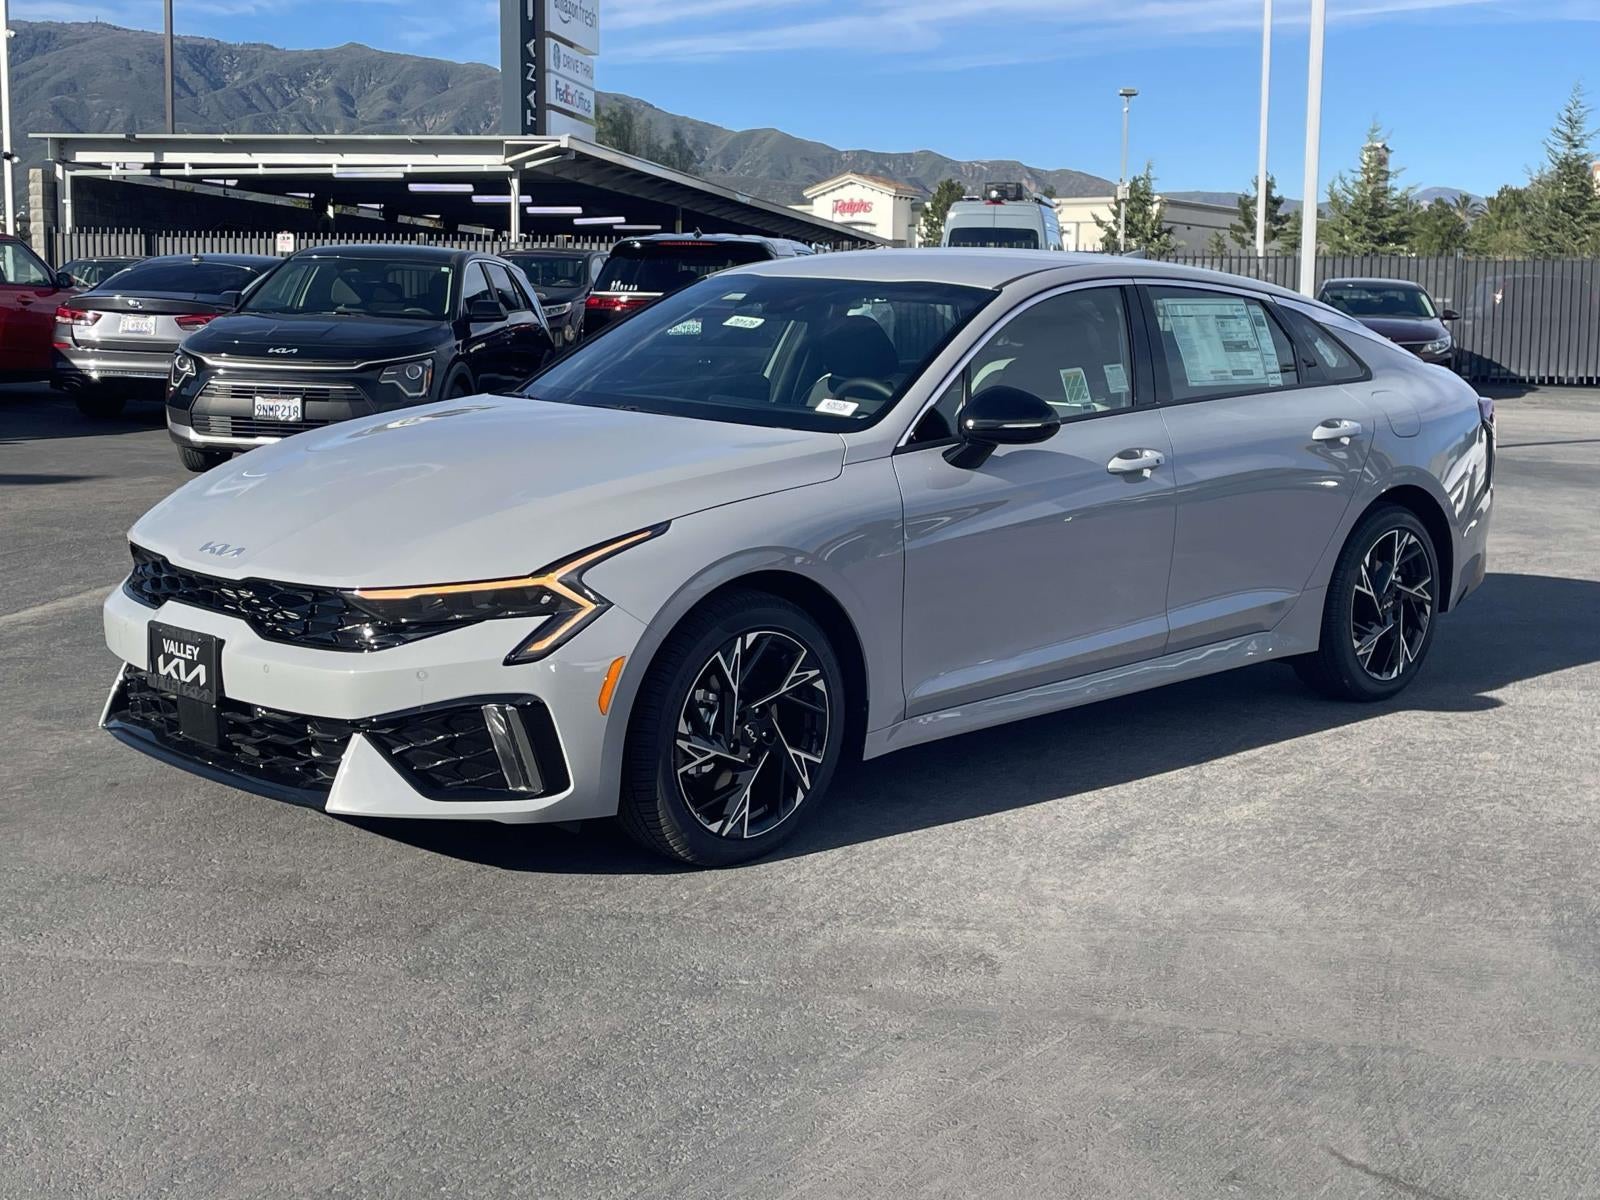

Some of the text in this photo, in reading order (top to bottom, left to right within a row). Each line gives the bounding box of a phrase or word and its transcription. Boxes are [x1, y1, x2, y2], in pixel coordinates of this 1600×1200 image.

[526, 39, 536, 135] TANA
[832, 197, 873, 216] Ralphs
[256, 404, 299, 418] 9NMP218
[200, 541, 246, 557] KIA
[162, 638, 200, 661] VALLEY
[157, 653, 207, 687] KIA
